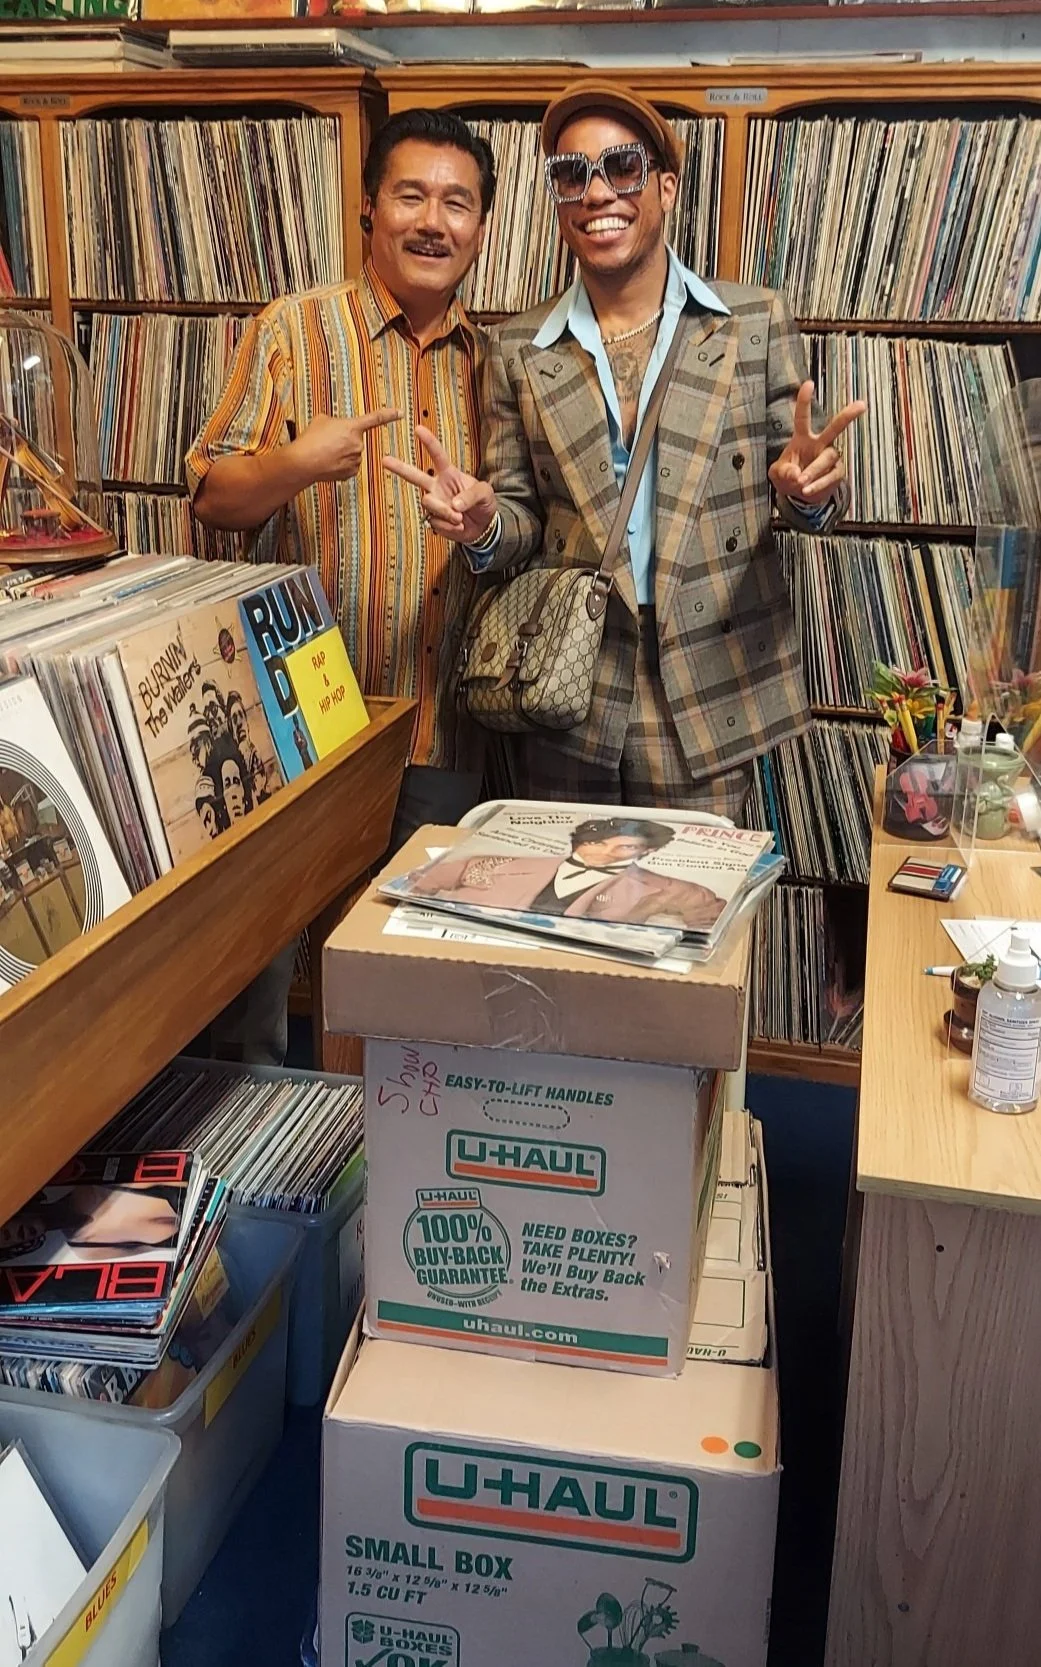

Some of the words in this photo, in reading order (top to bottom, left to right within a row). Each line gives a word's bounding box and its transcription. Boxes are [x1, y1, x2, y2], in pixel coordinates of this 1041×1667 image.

[242, 572, 325, 661] RUN
[311, 650, 326, 671] RAP
[322, 673, 330, 688] &
[318, 696, 331, 715] HIP
[331, 685, 346, 706] HOP
[144, 708, 169, 738] The
[681, 826, 763, 843] PRINCE
[445, 1074, 543, 1099] EASY-TO-LIFT
[545, 1086, 615, 1107] HANDLES
[416, 1213, 492, 1244] 100%
[521, 1222, 567, 1240] NEED
[571, 1228, 638, 1249] BOXES?
[413, 1245, 505, 1266] BUY-BACK
[522, 1240, 564, 1259] TAKE
[567, 1246, 637, 1266] PLENTY!
[521, 1258, 562, 1277] We'll
[567, 1265, 598, 1284] Buy
[602, 1268, 647, 1287] Back
[520, 1277, 547, 1294] the
[552, 1281, 609, 1302] Extras.
[463, 1318, 578, 1344] uhaul.com
[686, 1346, 727, 1357] U-HAU
[345, 1534, 444, 1571] SMALL
[455, 1550, 513, 1581] BOX
[346, 1564, 362, 1577] 16
[392, 1574, 400, 1582] x
[405, 1573, 421, 1586] 12
[451, 1583, 459, 1591] x
[465, 1582, 480, 1594] 12
[85, 1570, 117, 1632] BLUES
[347, 1581, 372, 1597] 1.5
[376, 1585, 401, 1601] CU
[404, 1590, 428, 1605] FT
[379, 1625, 453, 1646] U-HAUL
[379, 1638, 453, 1656] BOXES
